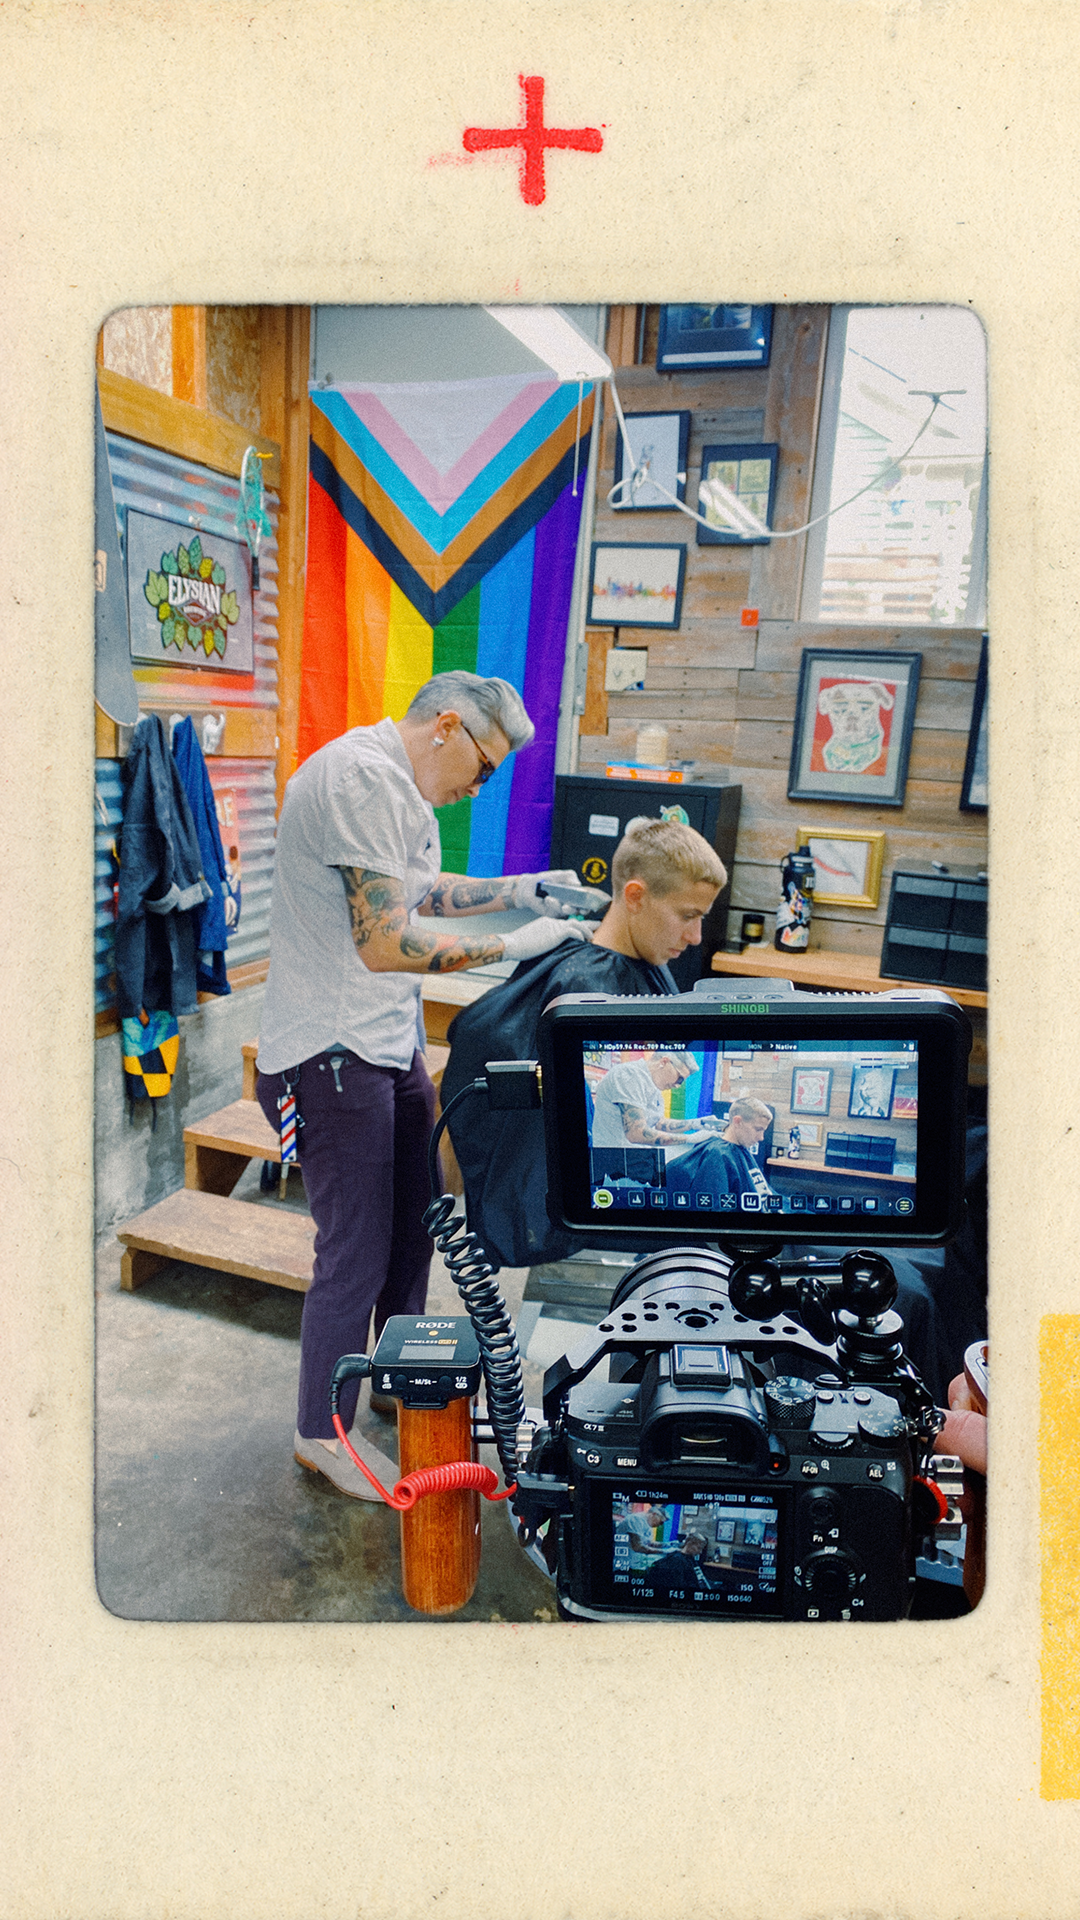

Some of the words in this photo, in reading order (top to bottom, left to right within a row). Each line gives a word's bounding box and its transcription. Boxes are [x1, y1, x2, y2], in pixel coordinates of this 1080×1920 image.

[168, 574, 220, 614] ELYSIAN
[720, 1004, 769, 1014] SHINOBI
[587, 1454, 600, 1464] C3
[617, 1458, 637, 1467] MENU
[868, 1469, 883, 1478] AEL
[813, 1534, 823, 1542] Fn
[632, 1588, 655, 1597] 1/125
[740, 1584, 754, 1592] ISO
[851, 1598, 864, 1607] C4
